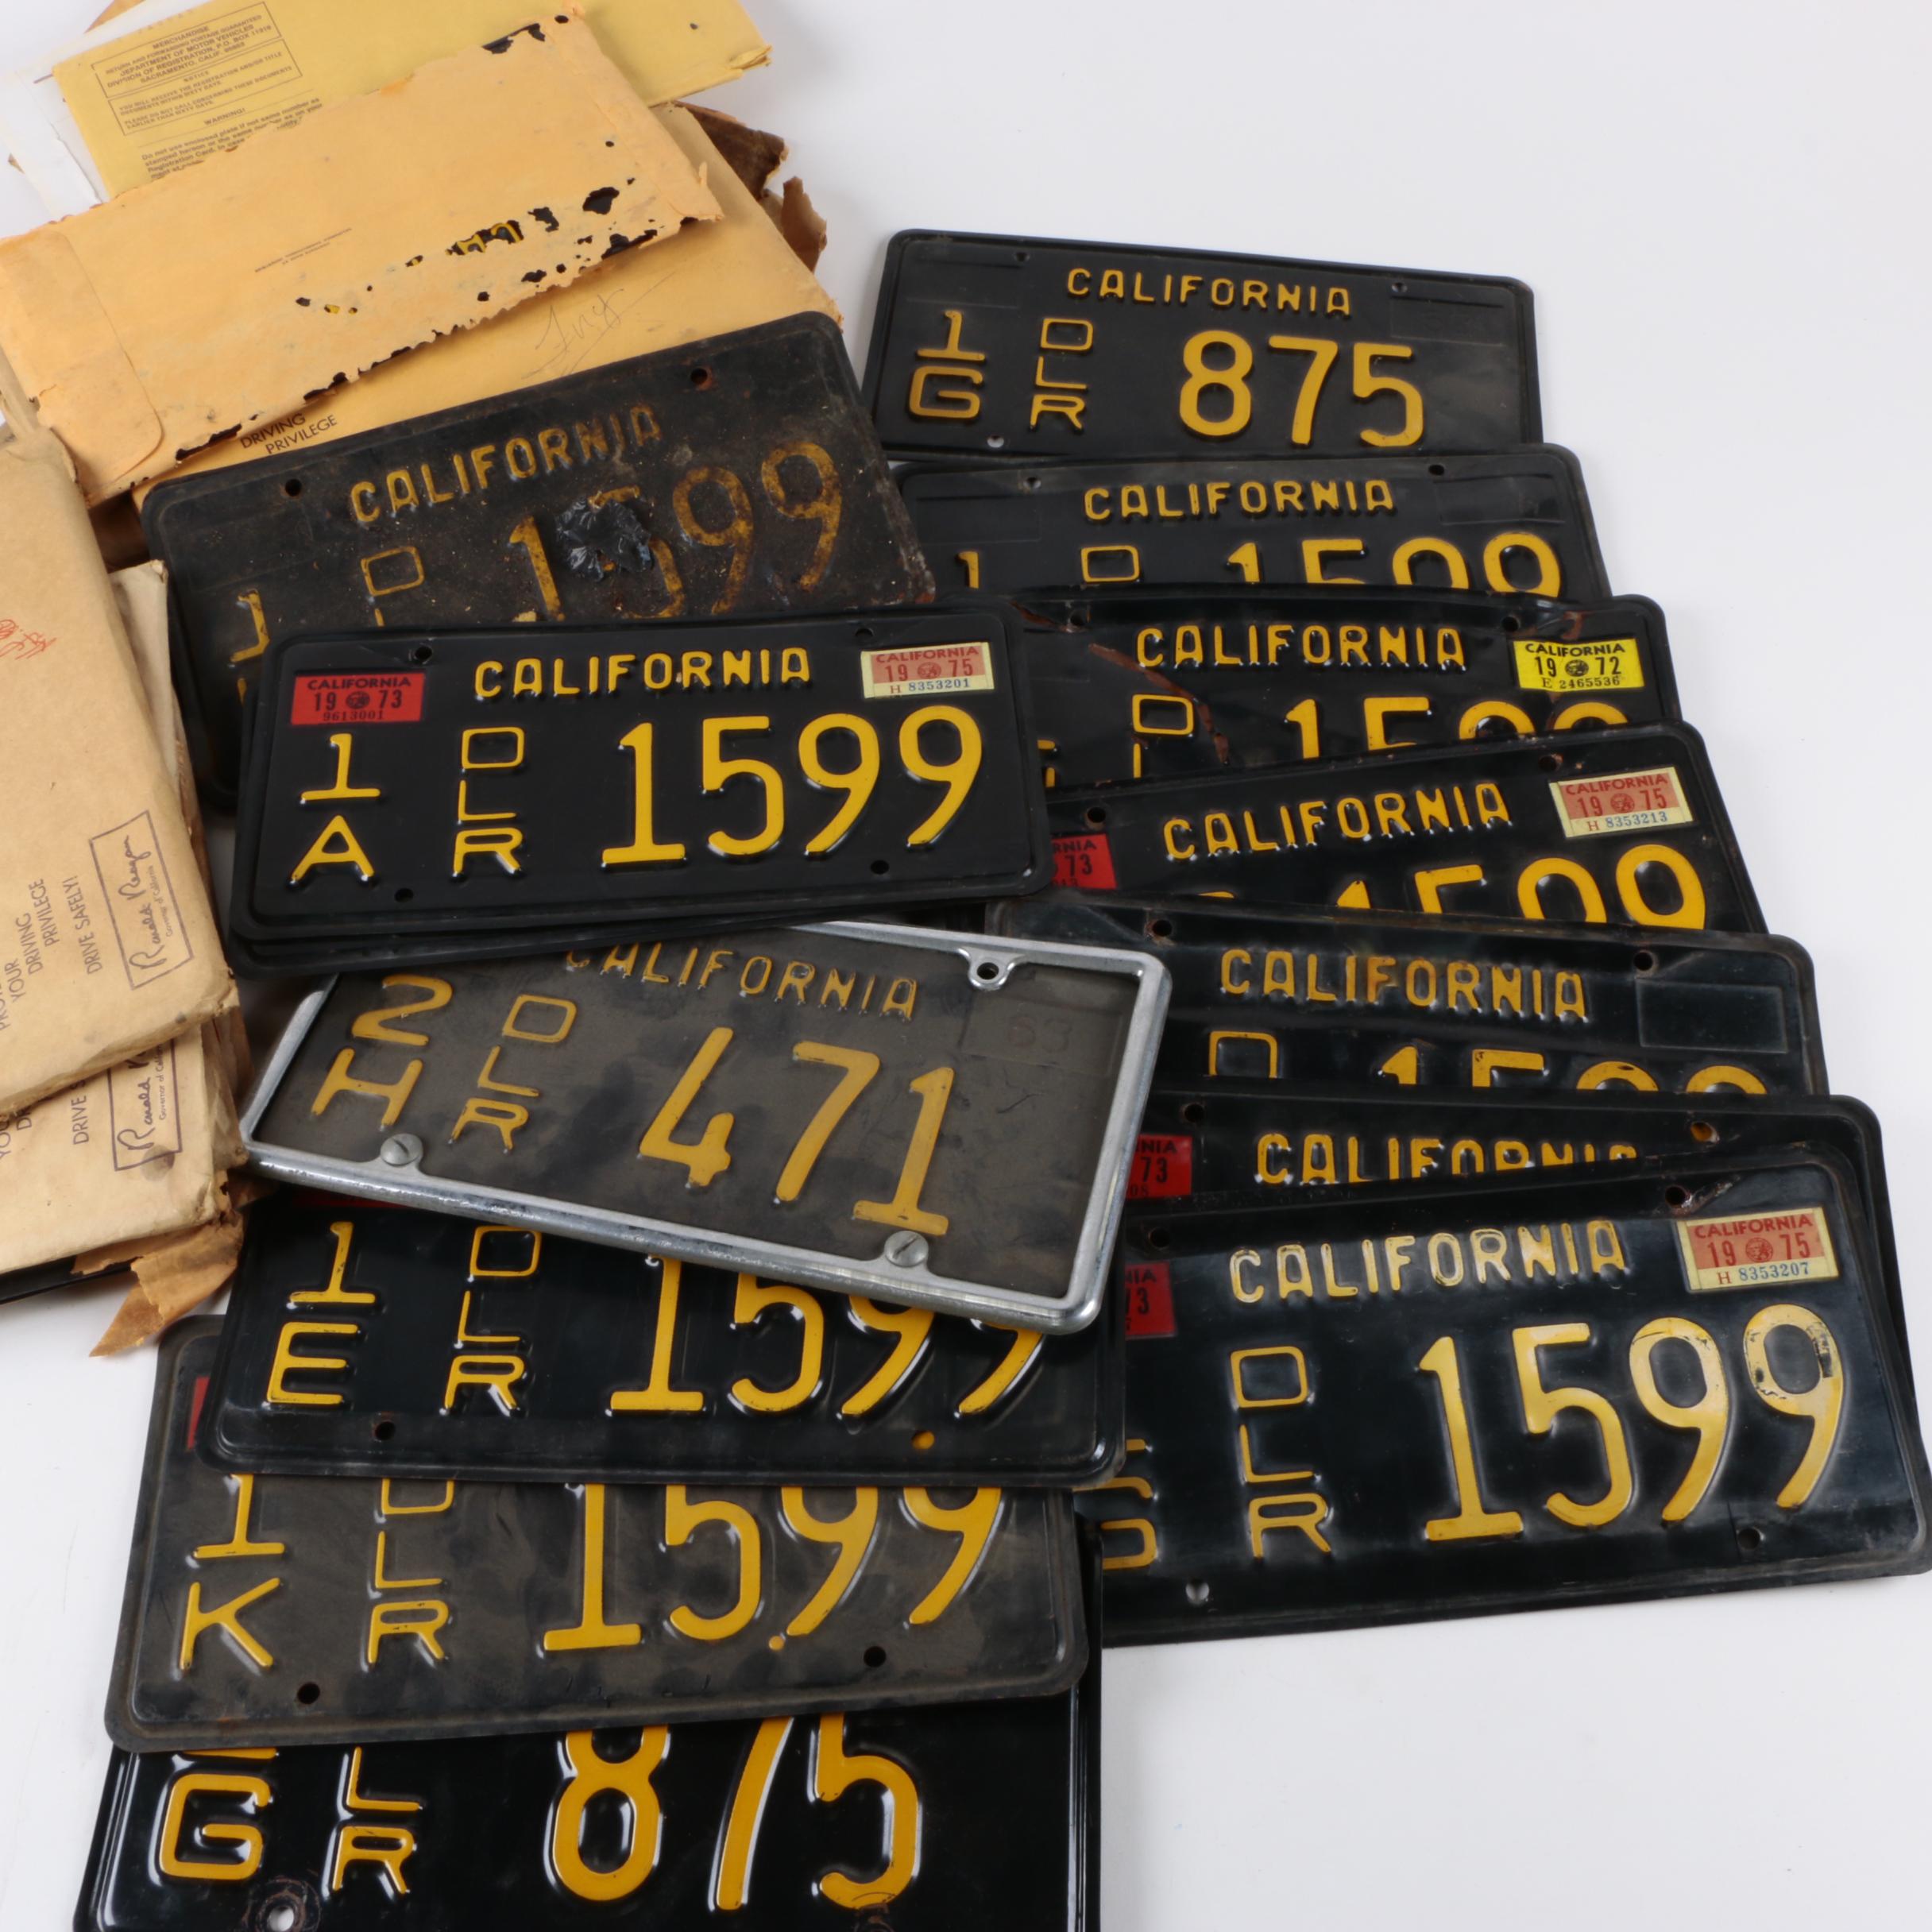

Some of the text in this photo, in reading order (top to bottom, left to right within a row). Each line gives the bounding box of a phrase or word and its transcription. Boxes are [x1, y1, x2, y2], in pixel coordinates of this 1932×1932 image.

[152, 25, 209, 49] MERCHANDISE
[186, 37, 215, 52] MOTOR
[215, 23, 254, 41] VEHICLES
[232, 33, 249, 42] BOX
[264, 51, 282, 60] TITLE
[183, 70, 209, 82] NOTICE
[203, 107, 246, 125] WARNING!
[141, 152, 153, 160] Do
[168, 143, 183, 152] use
[184, 132, 218, 147] enclosed
[218, 125, 239, 137] plate
[245, 118, 259, 126] not
[259, 111, 281, 122] same
[144, 151, 180, 168] stamped
[231, 128, 253, 138] same
[305, 102, 324, 114] your
[146, 153, 194, 173] Registration
[194, 146, 216, 157] Card.
[1066, 267, 1351, 316] CALIFORNIA
[1029, 316, 1095, 430] DLR
[1178, 329, 1425, 448] 875
[239, 412, 307, 450] DRIVING
[265, 414, 338, 454] PRIVILEGE
[350, 404, 661, 524] CALIFORNIA
[1083, 478, 1394, 521] CALIFORNIA
[876, 646, 979, 663] CALIFORNIA
[1136, 624, 1466, 668] CALIFORNIA
[1525, 643, 1625, 657] CALIFORNIA
[307, 677, 412, 690] CALIFORNIA
[474, 646, 811, 699] CALIFORNIA
[886, 659, 973, 682] 19 75
[1534, 656, 1621, 678] 19 72
[1541, 675, 1621, 690] E 2465536
[315, 690, 403, 711] 19 73
[890, 678, 971, 694] H 8353201
[452, 725, 527, 876] DLR
[600, 705, 984, 866] 1599
[1566, 774, 1667, 795] CALIFORNIA
[1578, 788, 1667, 818] 19 75
[1163, 782, 1511, 860] CALIFORNIA
[1587, 811, 1667, 832] H 8353213
[1065, 853, 1094, 877] 73
[28, 878, 60, 947] PRIVILEGE
[62, 875, 102, 975] DRIVE SAFELY!
[159, 906, 174, 937] Governor
[14, 912, 44, 976] DRIVING
[4, 958, 26, 1003] YOUR
[1221, 949, 1586, 1019] CALIFORNIA
[71, 1095, 90, 1146] DRIVE
[158, 1084, 168, 1121] Governor
[449, 992, 578, 1153] DLR
[637, 1025, 956, 1238] 471
[1694, 1214, 1813, 1238] CALIFORNIA
[1229, 1219, 1629, 1304] CALIFORNIA
[1708, 1232, 1810, 1268] 19 75
[1717, 1262, 1810, 1285] H 8353207
[443, 1226, 541, 1411] DLR
[1229, 1345, 1332, 1559] DLR
[1418, 1303, 1845, 1543] 1599
[541, 1482, 1003, 1652] 1599
[331, 1746, 422, 1895] LR
[552, 1717, 921, 1912] 875
